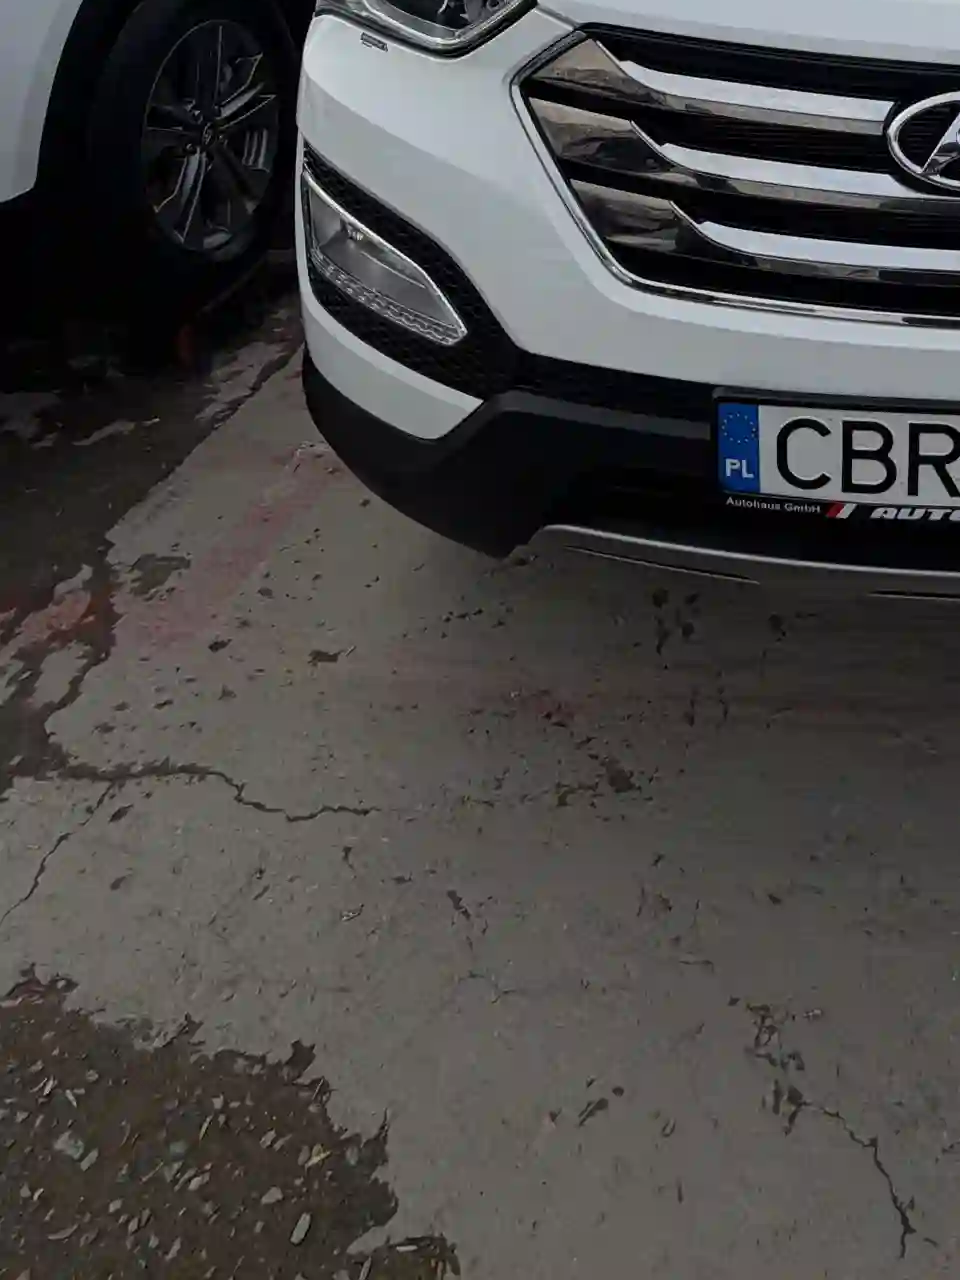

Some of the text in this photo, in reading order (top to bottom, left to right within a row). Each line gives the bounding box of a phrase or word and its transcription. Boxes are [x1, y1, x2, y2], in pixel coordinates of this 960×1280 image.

[725, 457, 755, 479] PL
[725, 495, 821, 514] Autohaus GmbH
